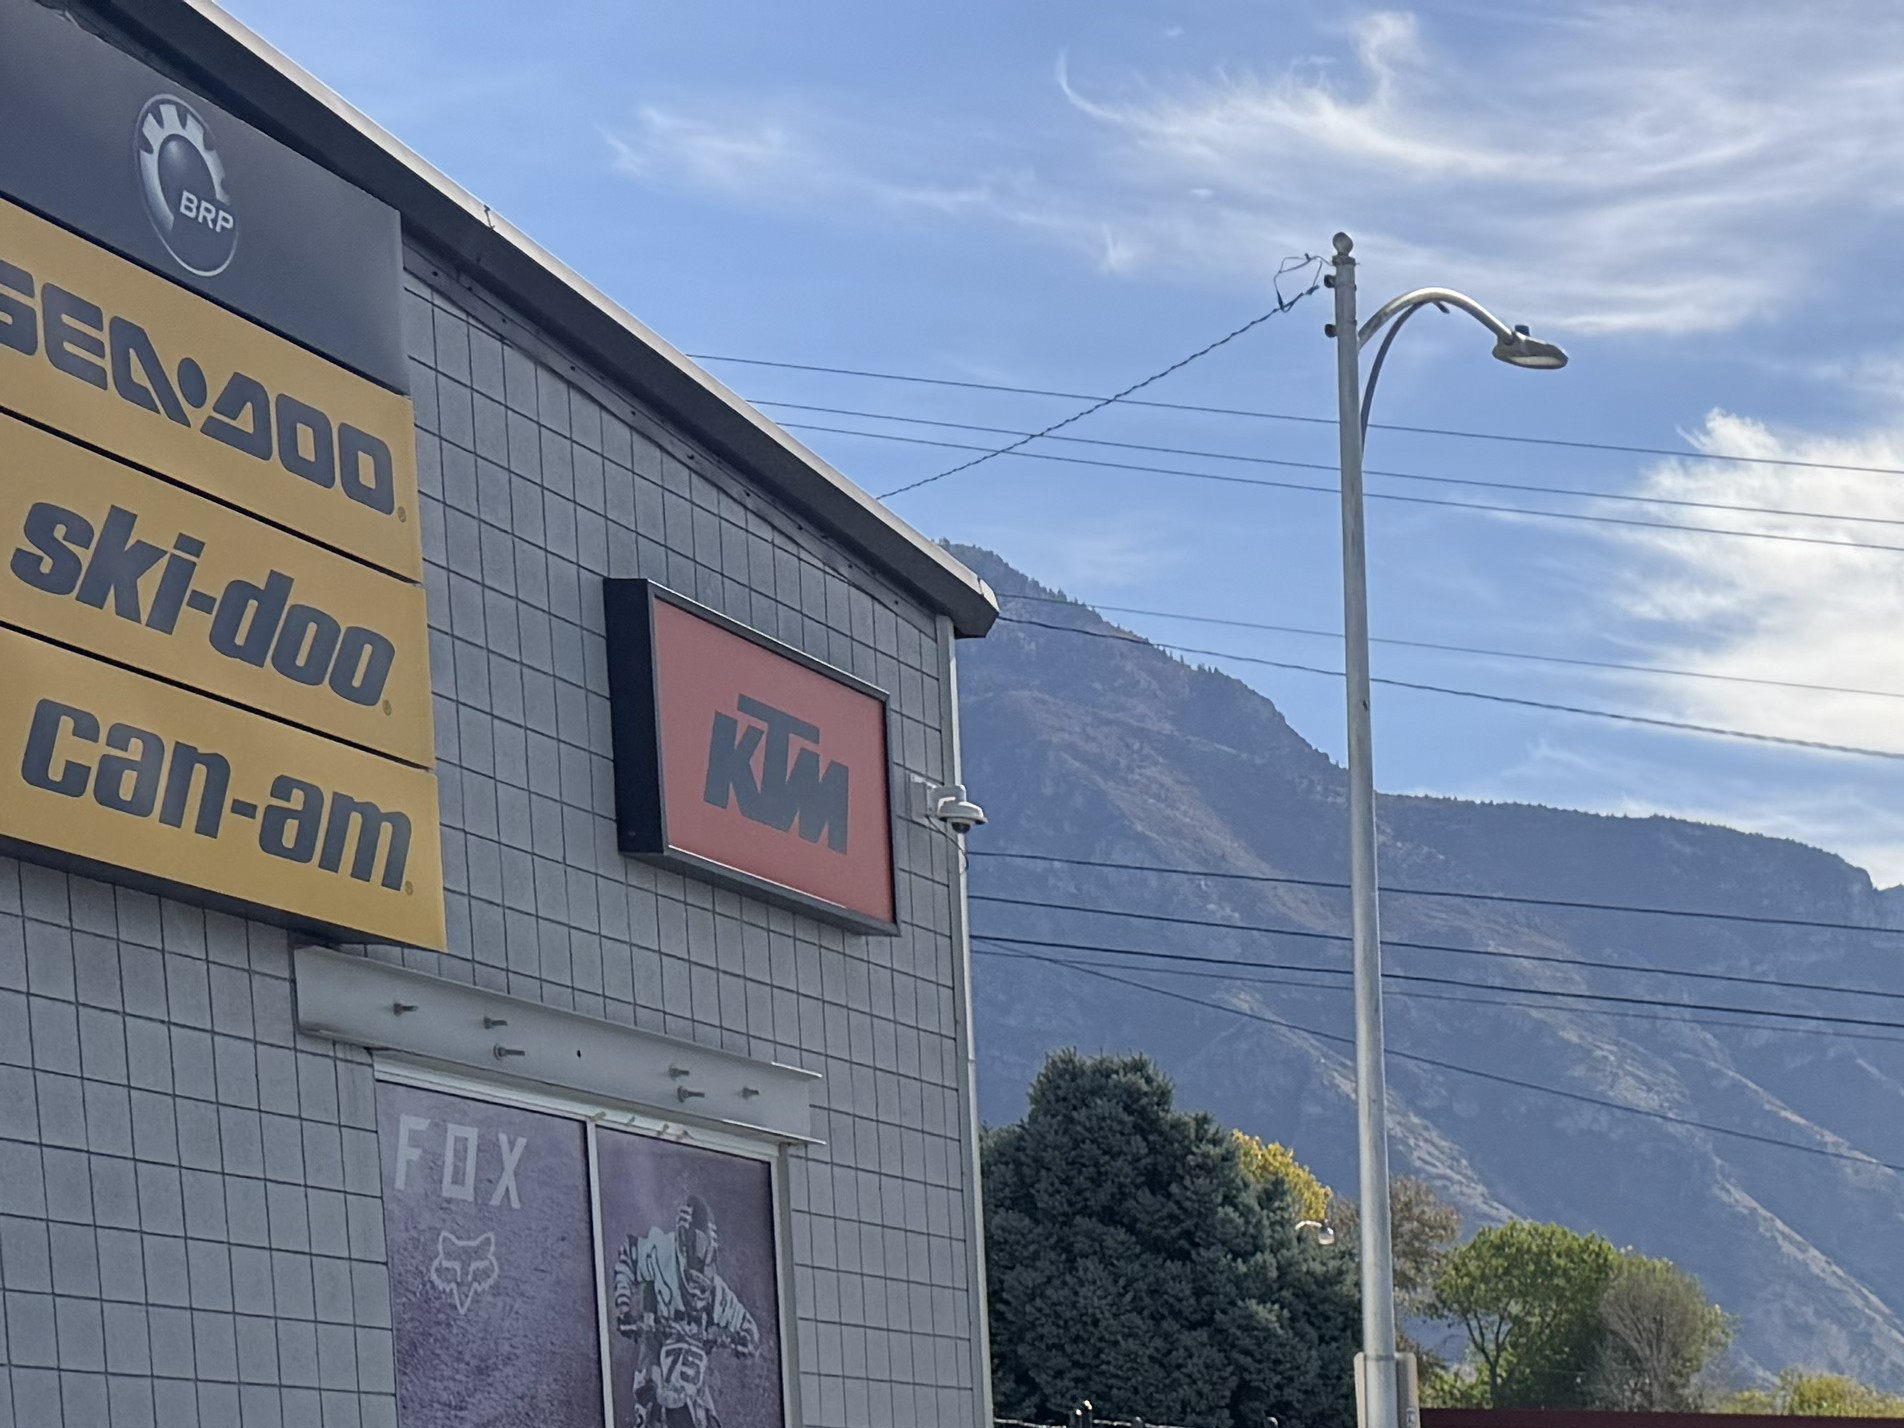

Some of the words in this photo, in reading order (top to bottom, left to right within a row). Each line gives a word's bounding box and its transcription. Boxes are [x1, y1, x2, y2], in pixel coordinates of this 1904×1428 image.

[179, 190, 234, 233] BRP
[11, 501, 396, 707] ski-doo
[22, 698, 412, 891] can-am
[703, 693, 850, 856] KTM
[395, 1114, 529, 1210] FOX
[663, 1346, 706, 1387] 75
